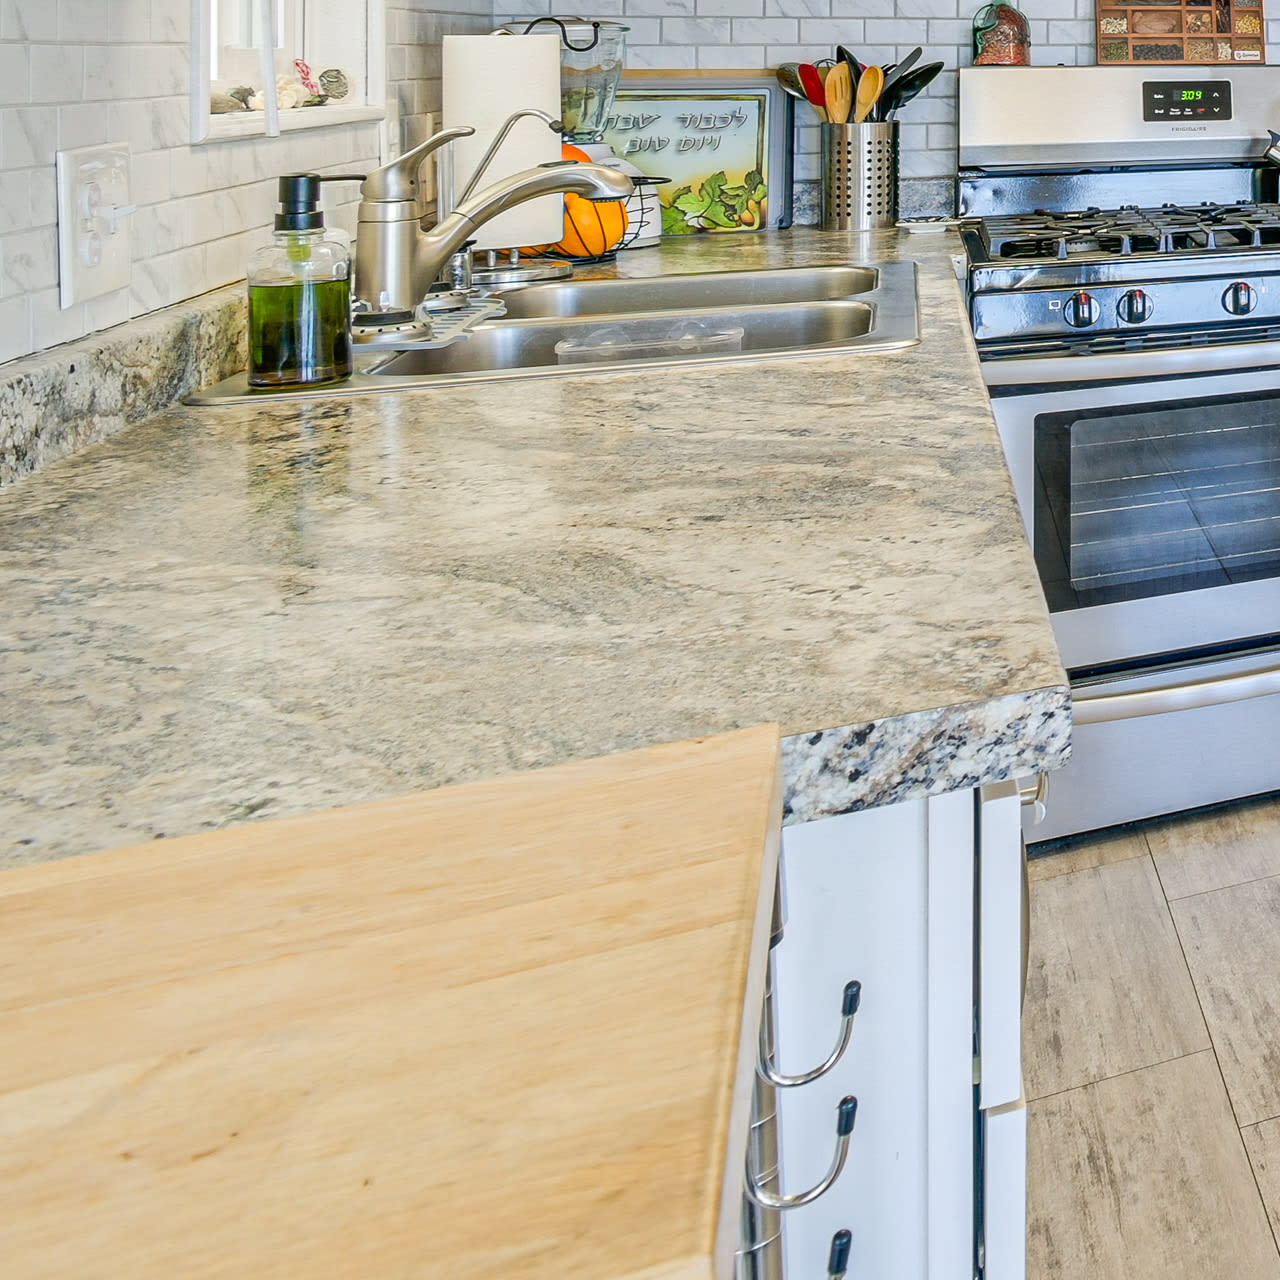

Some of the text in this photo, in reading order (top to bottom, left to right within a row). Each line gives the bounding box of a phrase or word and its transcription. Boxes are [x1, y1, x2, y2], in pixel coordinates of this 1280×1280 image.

[678, 106, 748, 130] לכבוד
[625, 135, 722, 154] ויום טוב
